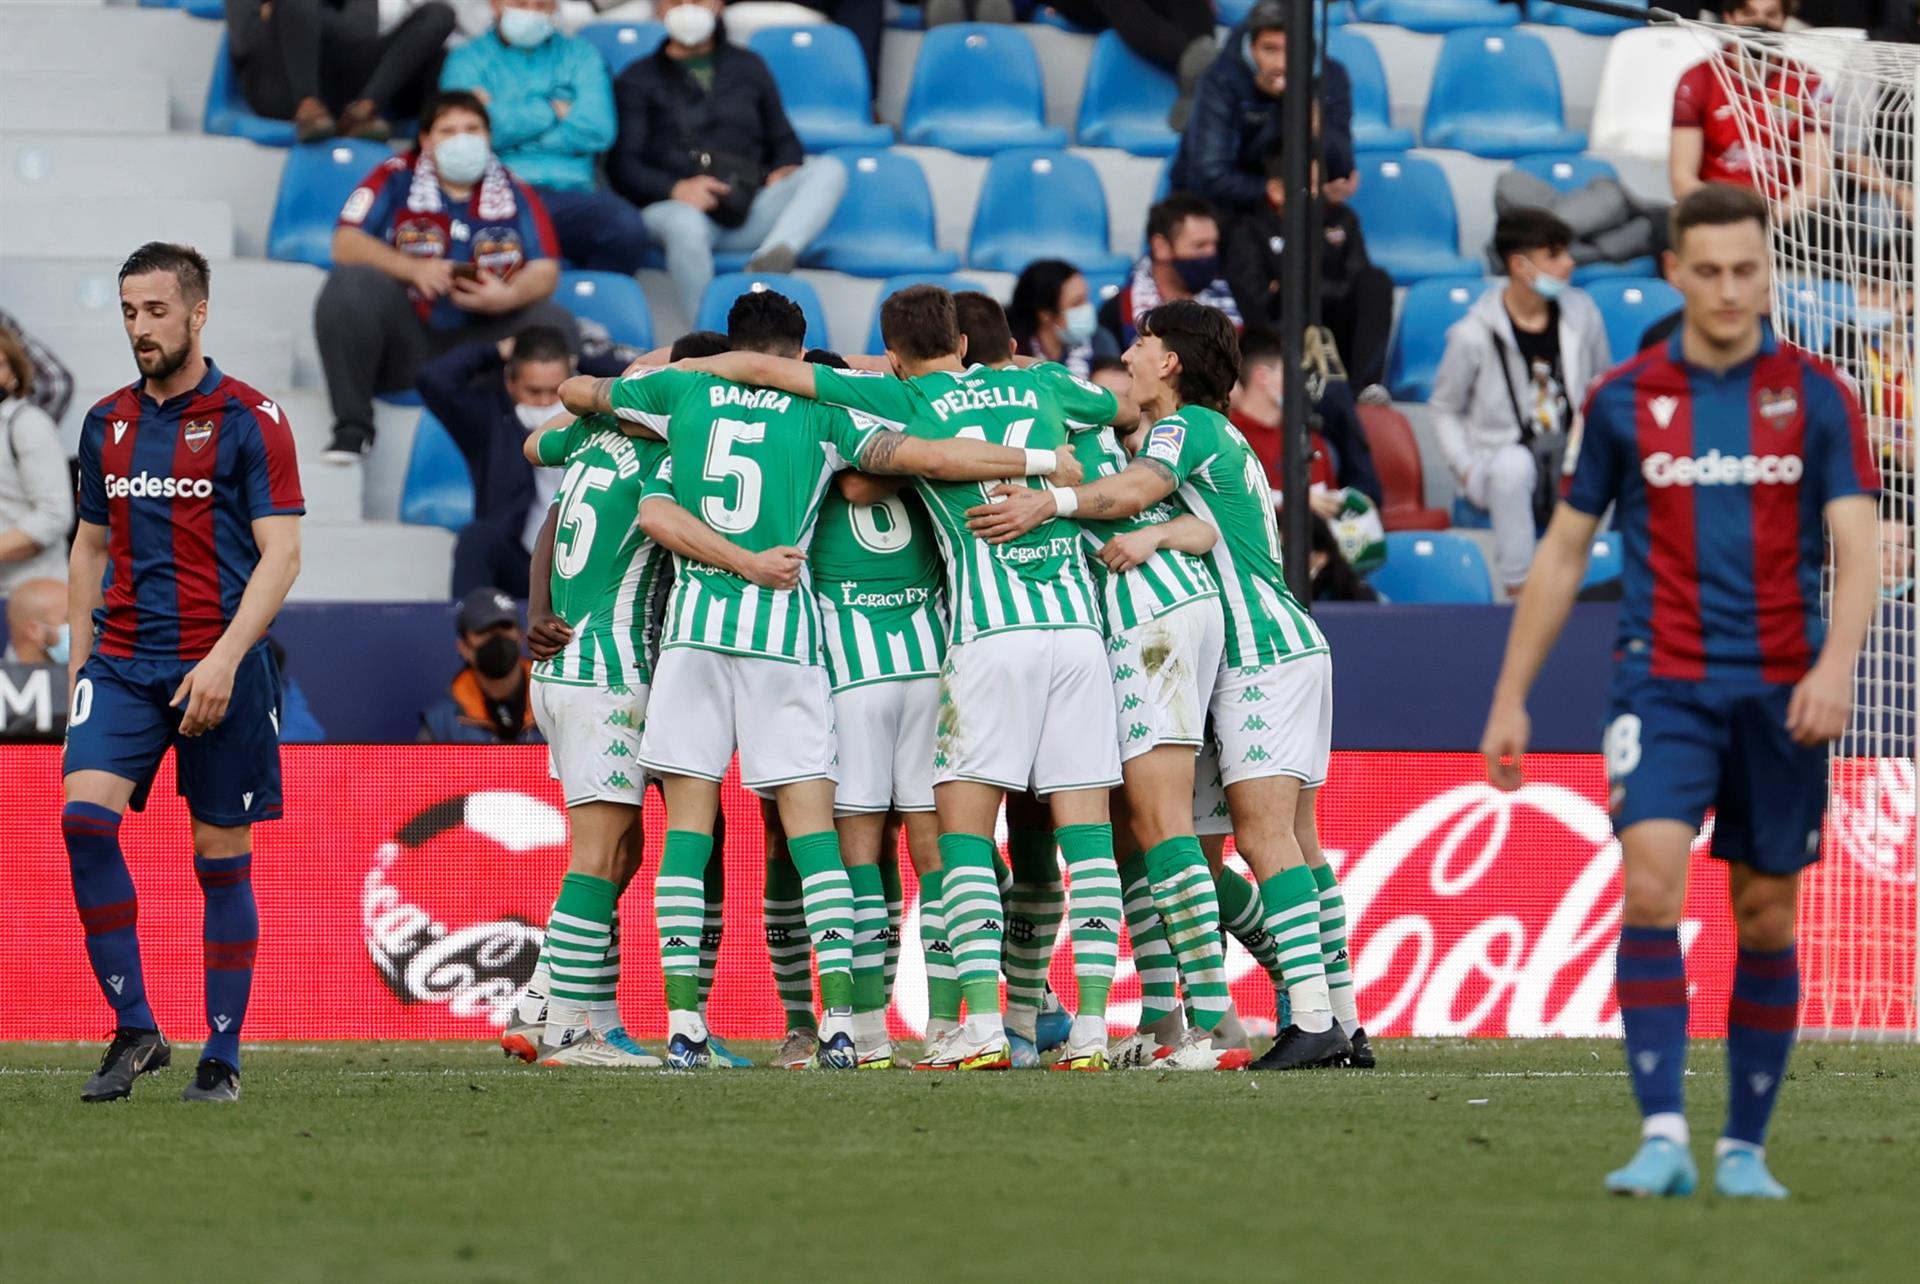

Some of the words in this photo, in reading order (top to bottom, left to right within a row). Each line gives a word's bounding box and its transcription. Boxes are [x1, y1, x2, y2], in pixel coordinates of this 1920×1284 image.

[709, 385, 791, 413] BARTRA
[931, 386, 1039, 421] PEZZELLA
[105, 470, 213, 499] Gedesco
[702, 418, 766, 534] 5
[1642, 448, 1803, 487] Gedesco
[555, 460, 617, 579] 15
[69, 678, 94, 727] 0
